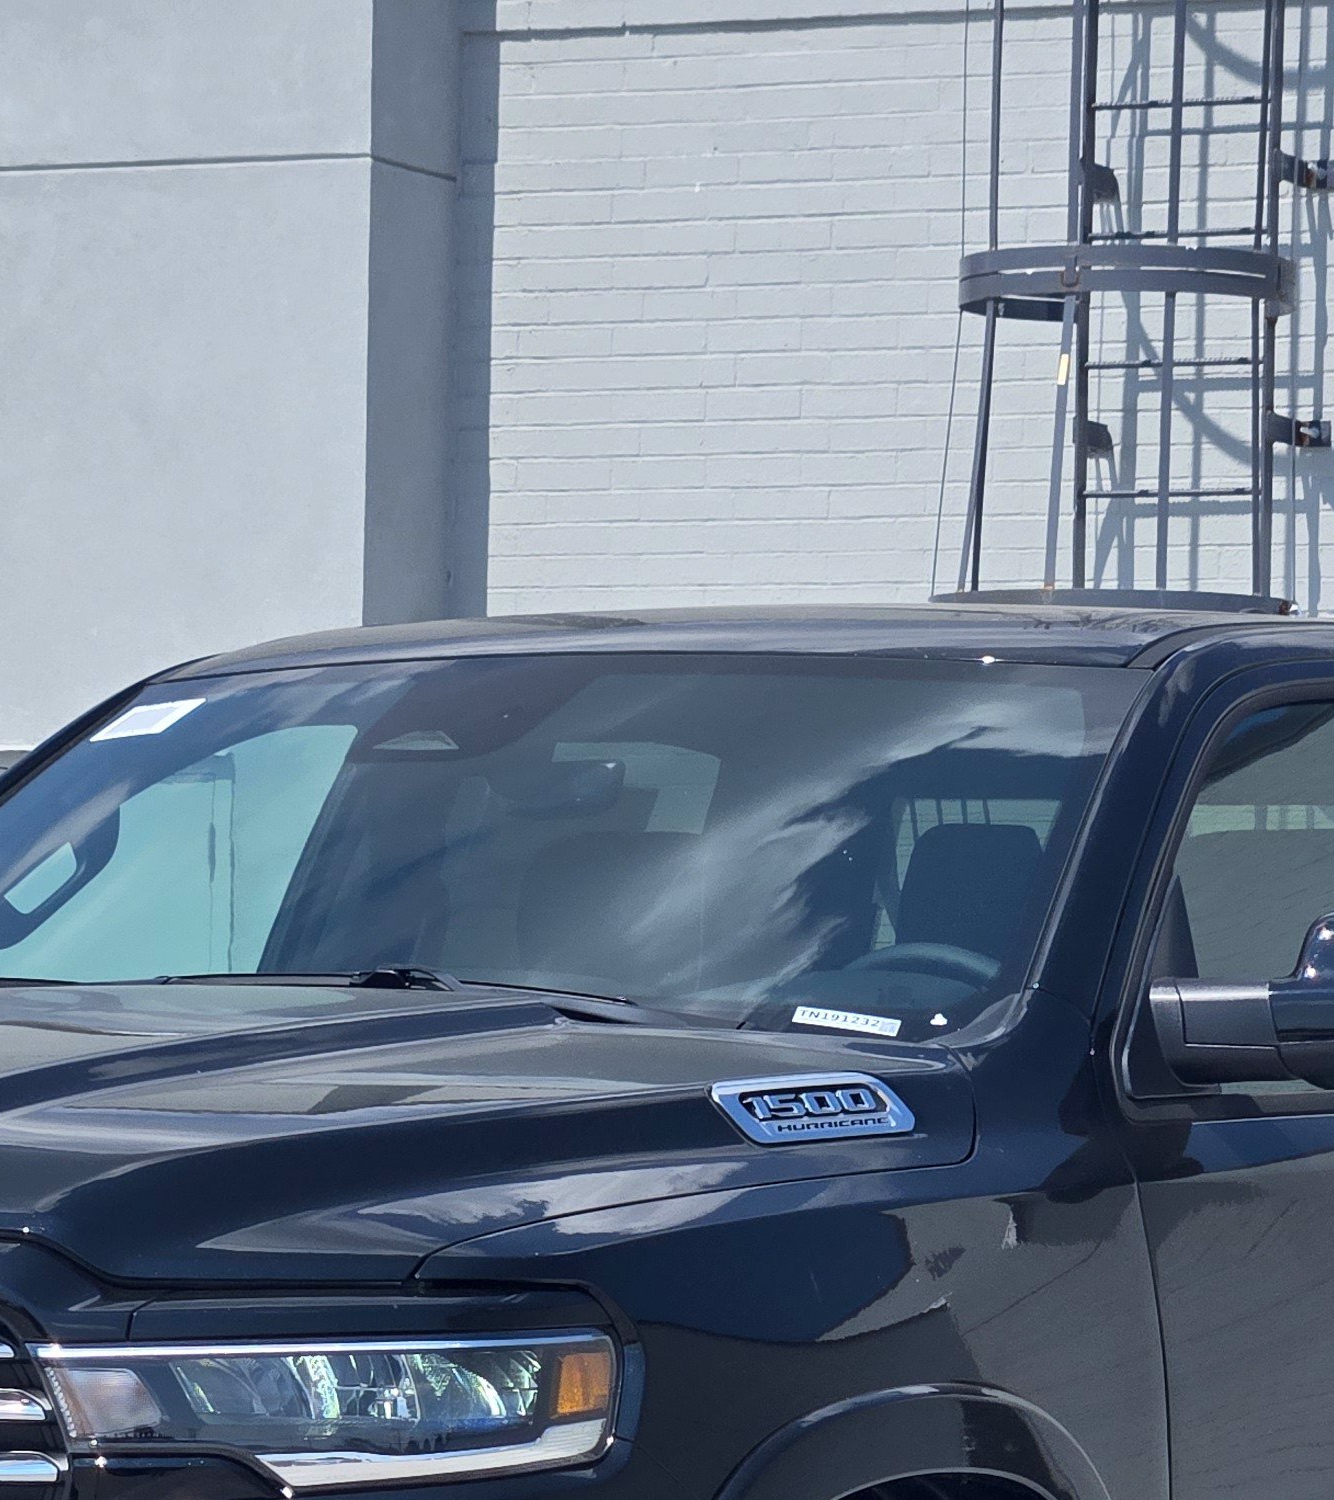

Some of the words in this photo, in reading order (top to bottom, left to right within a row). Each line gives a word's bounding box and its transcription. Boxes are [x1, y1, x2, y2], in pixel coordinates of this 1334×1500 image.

[799, 1009, 880, 1028] TN191232
[743, 1088, 876, 1120] 1500
[777, 1117, 889, 1133] HURRICANE
